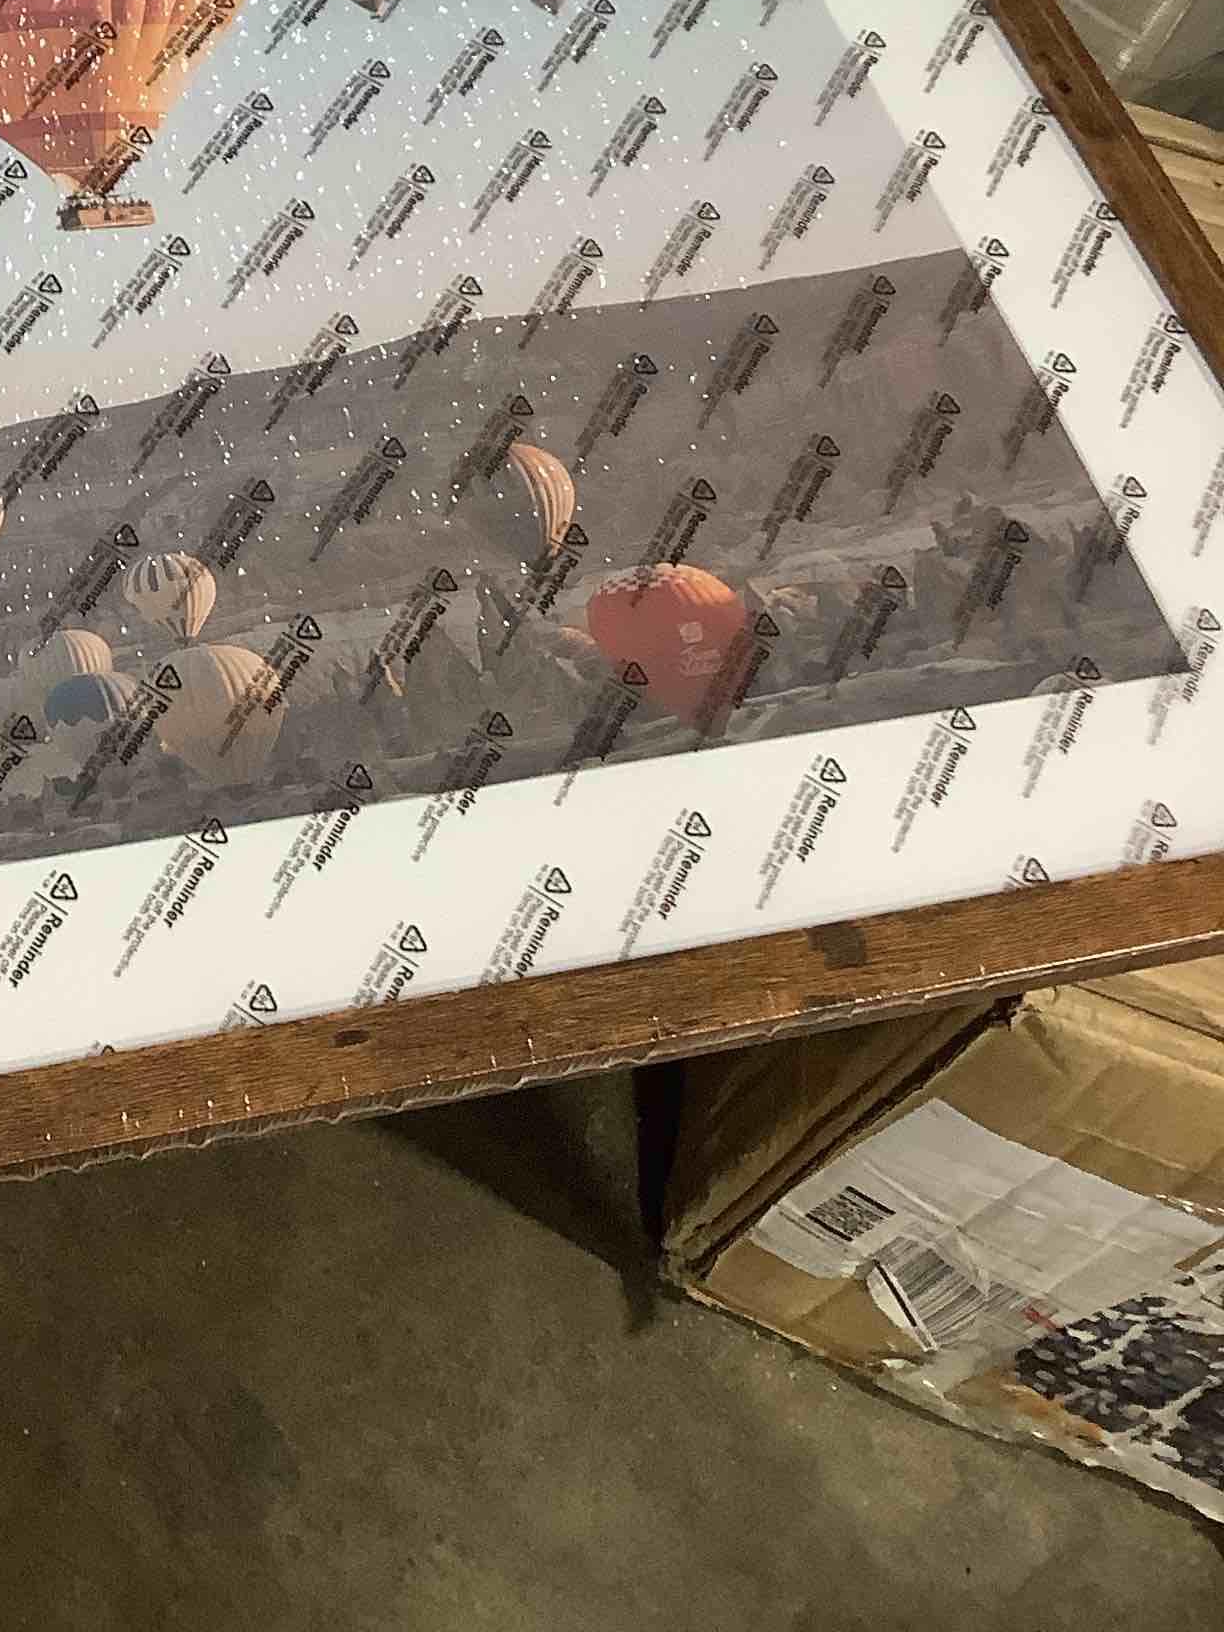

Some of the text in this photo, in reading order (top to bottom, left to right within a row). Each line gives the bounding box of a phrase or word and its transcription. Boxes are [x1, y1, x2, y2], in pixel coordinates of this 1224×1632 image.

[596, 696, 637, 761] Reminder
[1059, 690, 1092, 754] Reminder
[930, 741, 966, 807] Reminder
[312, 801, 360, 871] Reminder
[797, 794, 836, 862] Reminder
[163, 856, 214, 928] Reminder
[658, 848, 700, 919] Reminder
[8, 913, 63, 987] Reminder
[514, 906, 559, 978] Reminder
